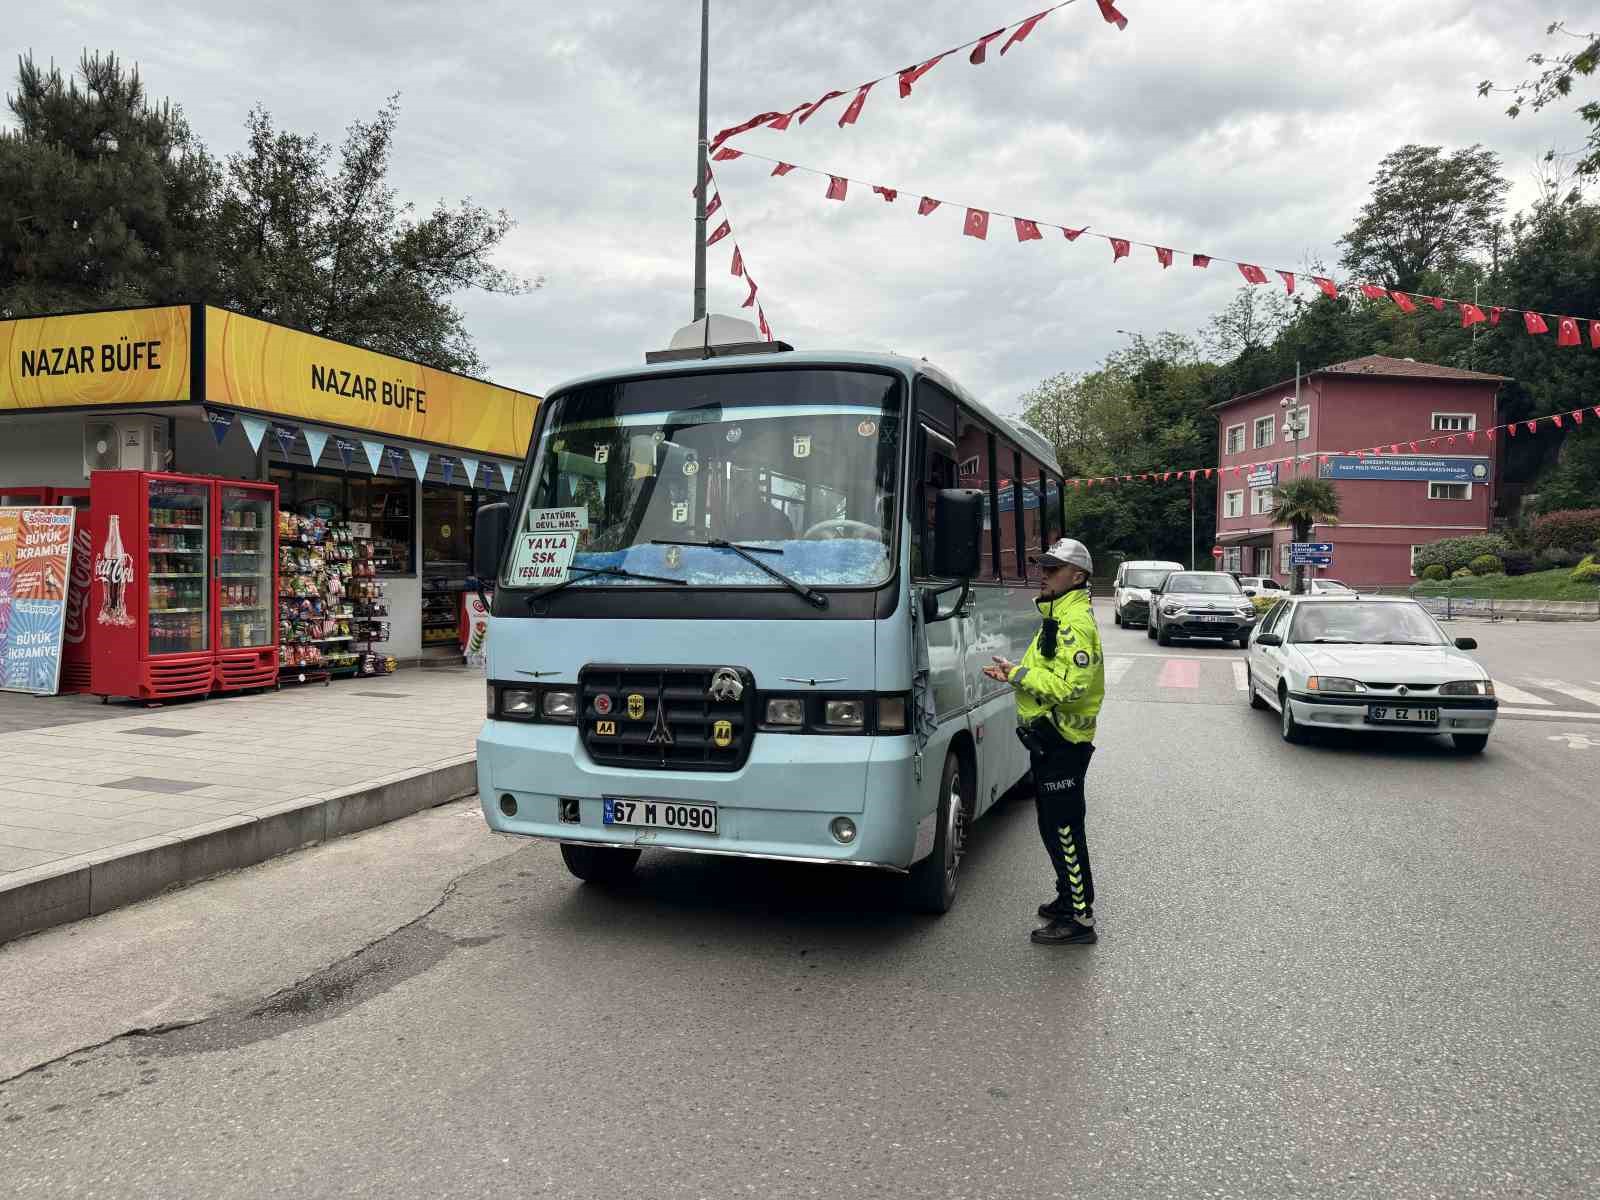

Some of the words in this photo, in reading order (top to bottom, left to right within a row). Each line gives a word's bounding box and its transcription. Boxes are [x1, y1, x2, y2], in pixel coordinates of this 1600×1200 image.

[22, 346, 95, 377] NAZAR
[101, 336, 161, 373] BÜFE
[311, 364, 377, 402] NAZAR
[382, 378, 426, 414] BÜFE
[540, 510, 576, 520] ATATÜRK
[26, 528, 61, 544] BÜYÜK
[17, 543, 69, 559] İKRAMİYE
[527, 538, 567, 550] YAYLA
[531, 552, 556, 563] SSK
[16, 631, 51, 645] BÜYÜK
[1375, 707, 1387, 719] 67
[1396, 709, 1408, 720] EZ
[1418, 710, 1436, 721] 118
[599, 722, 613, 733] AA
[614, 802, 636, 822] 67
[645, 804, 657, 824] M
[665, 806, 713, 829] 0090
